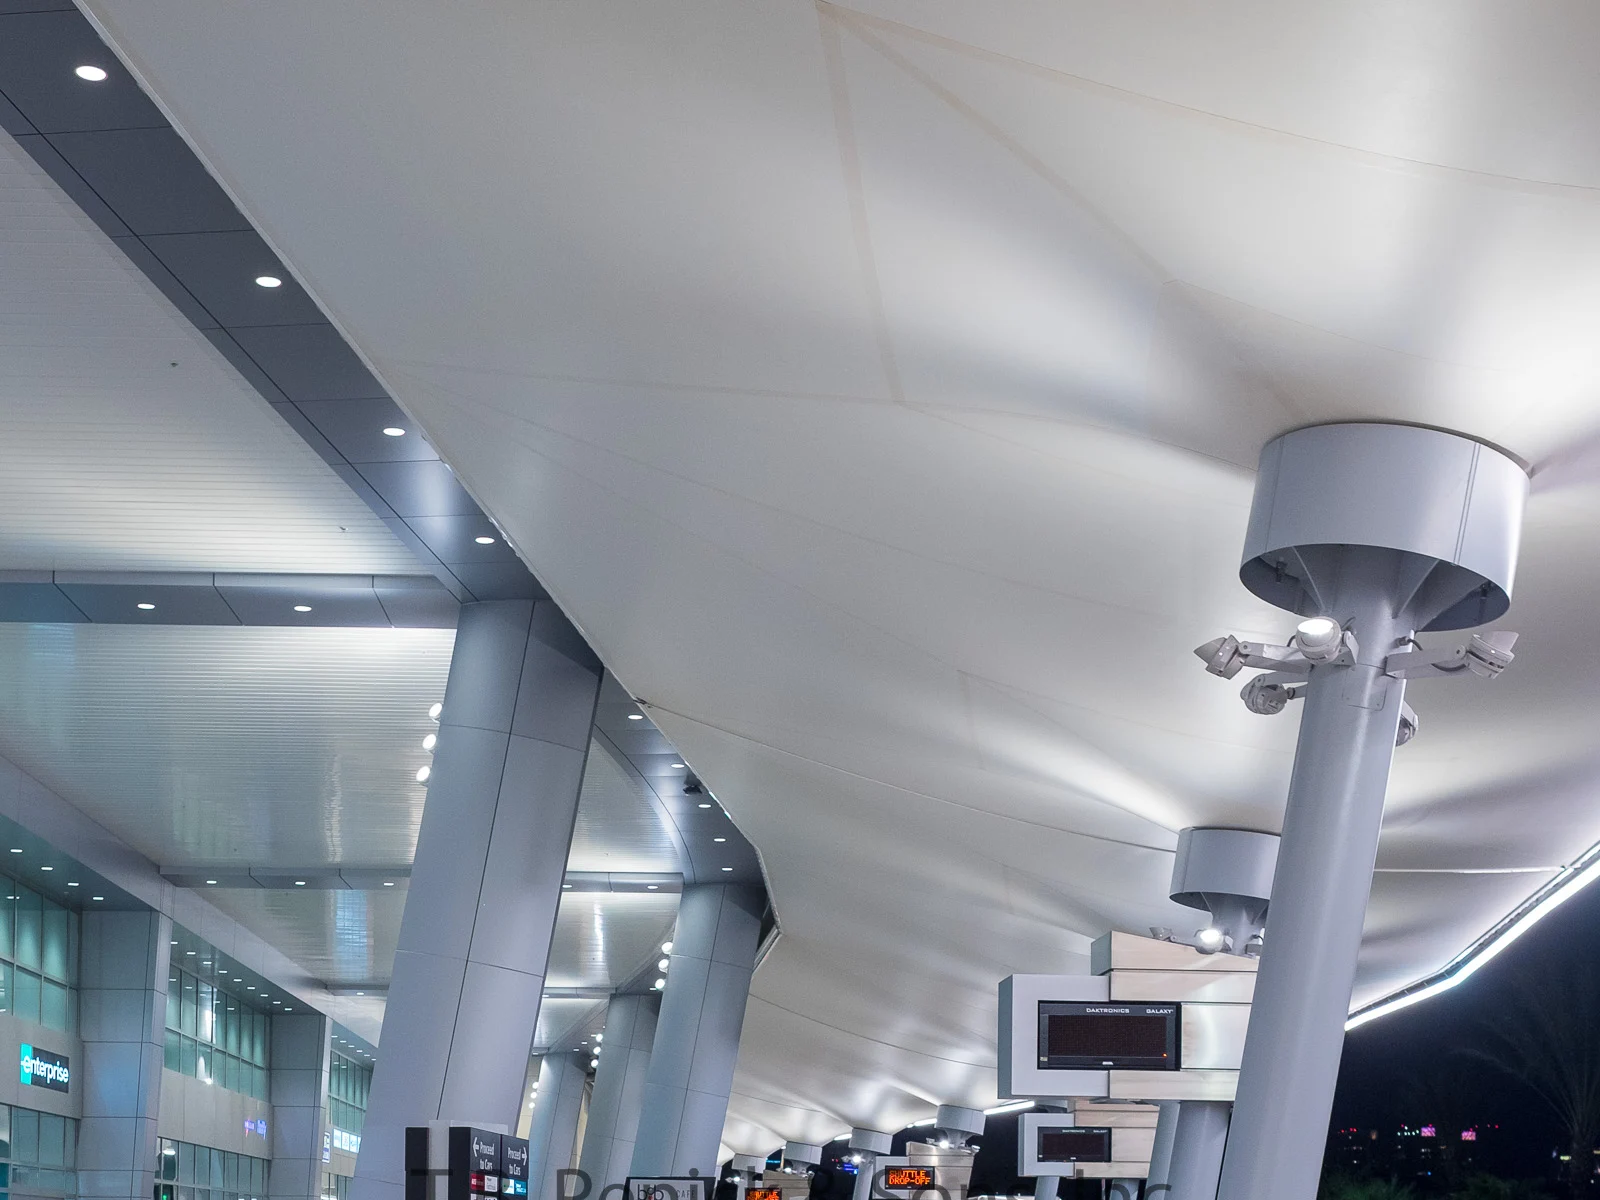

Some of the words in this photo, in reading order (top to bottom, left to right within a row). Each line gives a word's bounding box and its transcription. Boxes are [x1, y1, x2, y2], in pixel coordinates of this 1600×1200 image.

[21, 1055, 69, 1084] enterprise
[480, 1141, 495, 1156] Proceed
[508, 1147, 521, 1160] Proceed
[485, 1159, 493, 1172] Cars
[889, 1170, 927, 1178] SHUTTLE
[889, 1177, 931, 1185] DROP-OFF
